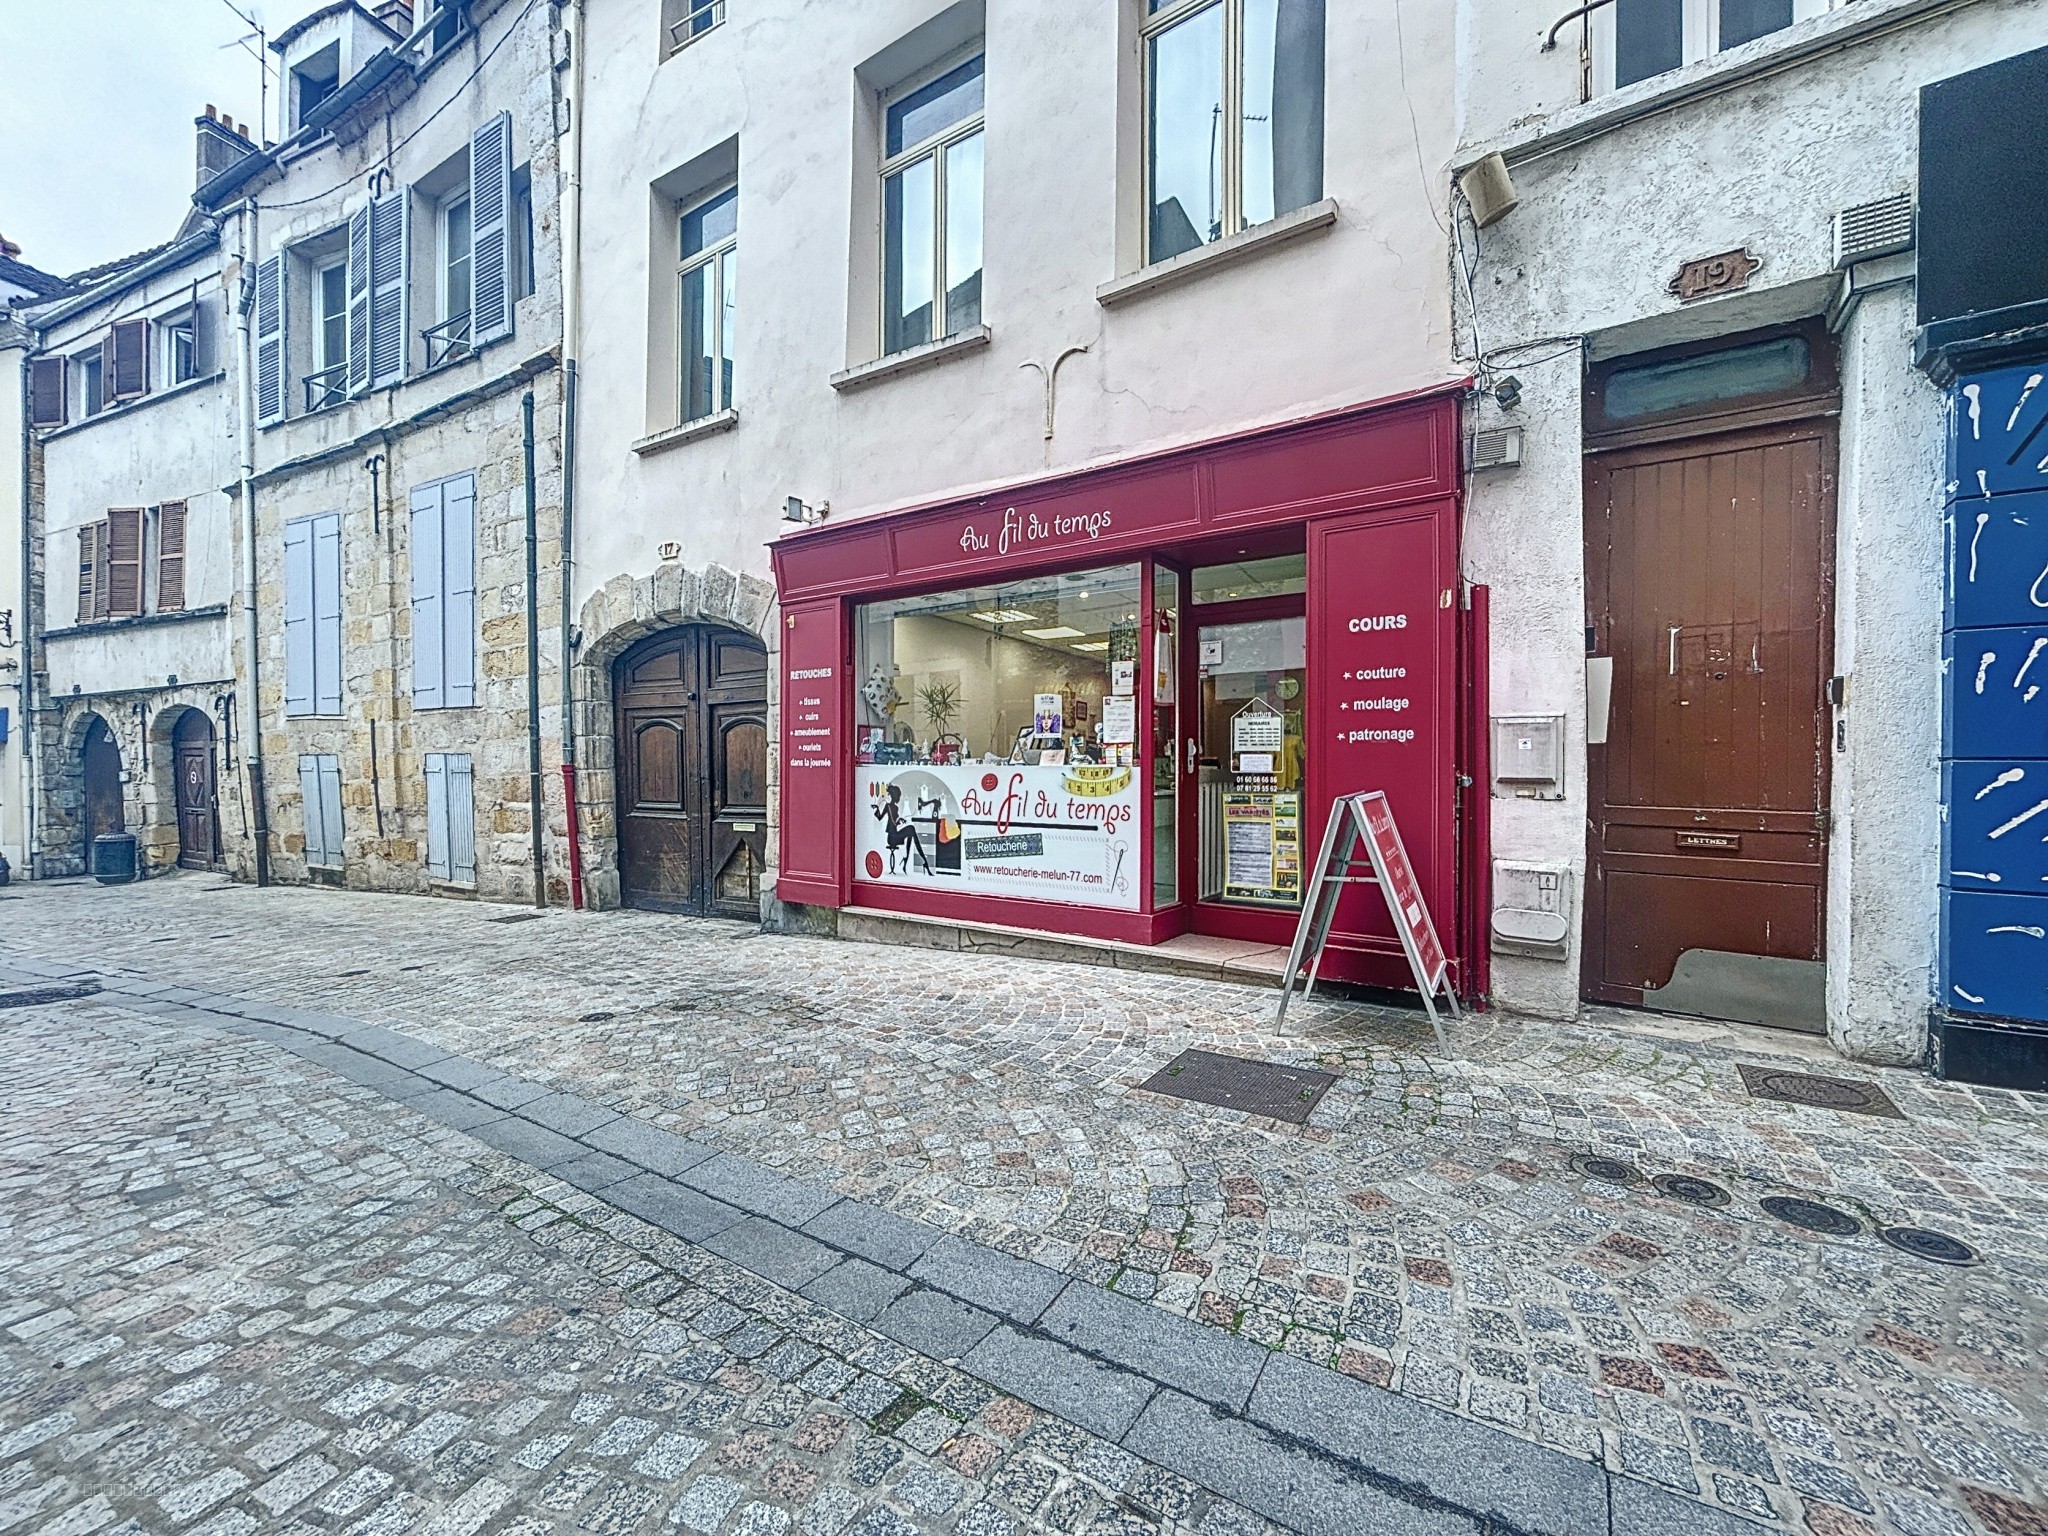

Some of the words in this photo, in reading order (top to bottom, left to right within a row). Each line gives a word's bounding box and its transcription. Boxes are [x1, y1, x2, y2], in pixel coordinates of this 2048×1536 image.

[1692, 260, 1735, 292] 19
[960, 526, 989, 552] Au
[999, 507, 1022, 554] fil
[1027, 513, 1049, 540] du
[1053, 510, 1111, 539] temps
[664, 542, 674, 555] 17
[1348, 614, 1407, 633] COURS
[790, 668, 832, 680] RETOUCHES
[1356, 666, 1407, 680] couture
[803, 697, 821, 706] tissus
[1353, 697, 1409, 711] moulage
[805, 712, 819, 721] cuirs
[794, 728, 831, 736] ameublement
[1349, 729, 1415, 743] patronage
[803, 744, 821, 752] ourlets
[790, 758, 803, 767] dans
[804, 758, 809, 767] la
[810, 758, 831, 769] journée
[961, 788, 992, 816] Au
[997, 773, 1029, 834] fil
[1034, 789, 1058, 819] du
[1067, 797, 1131, 834] temps
[977, 840, 1028, 853] Retoucherie
[1687, 837, 1728, 845] LETTRES
[973, 864, 1103, 884] www.retoucherie-melun-77.com
